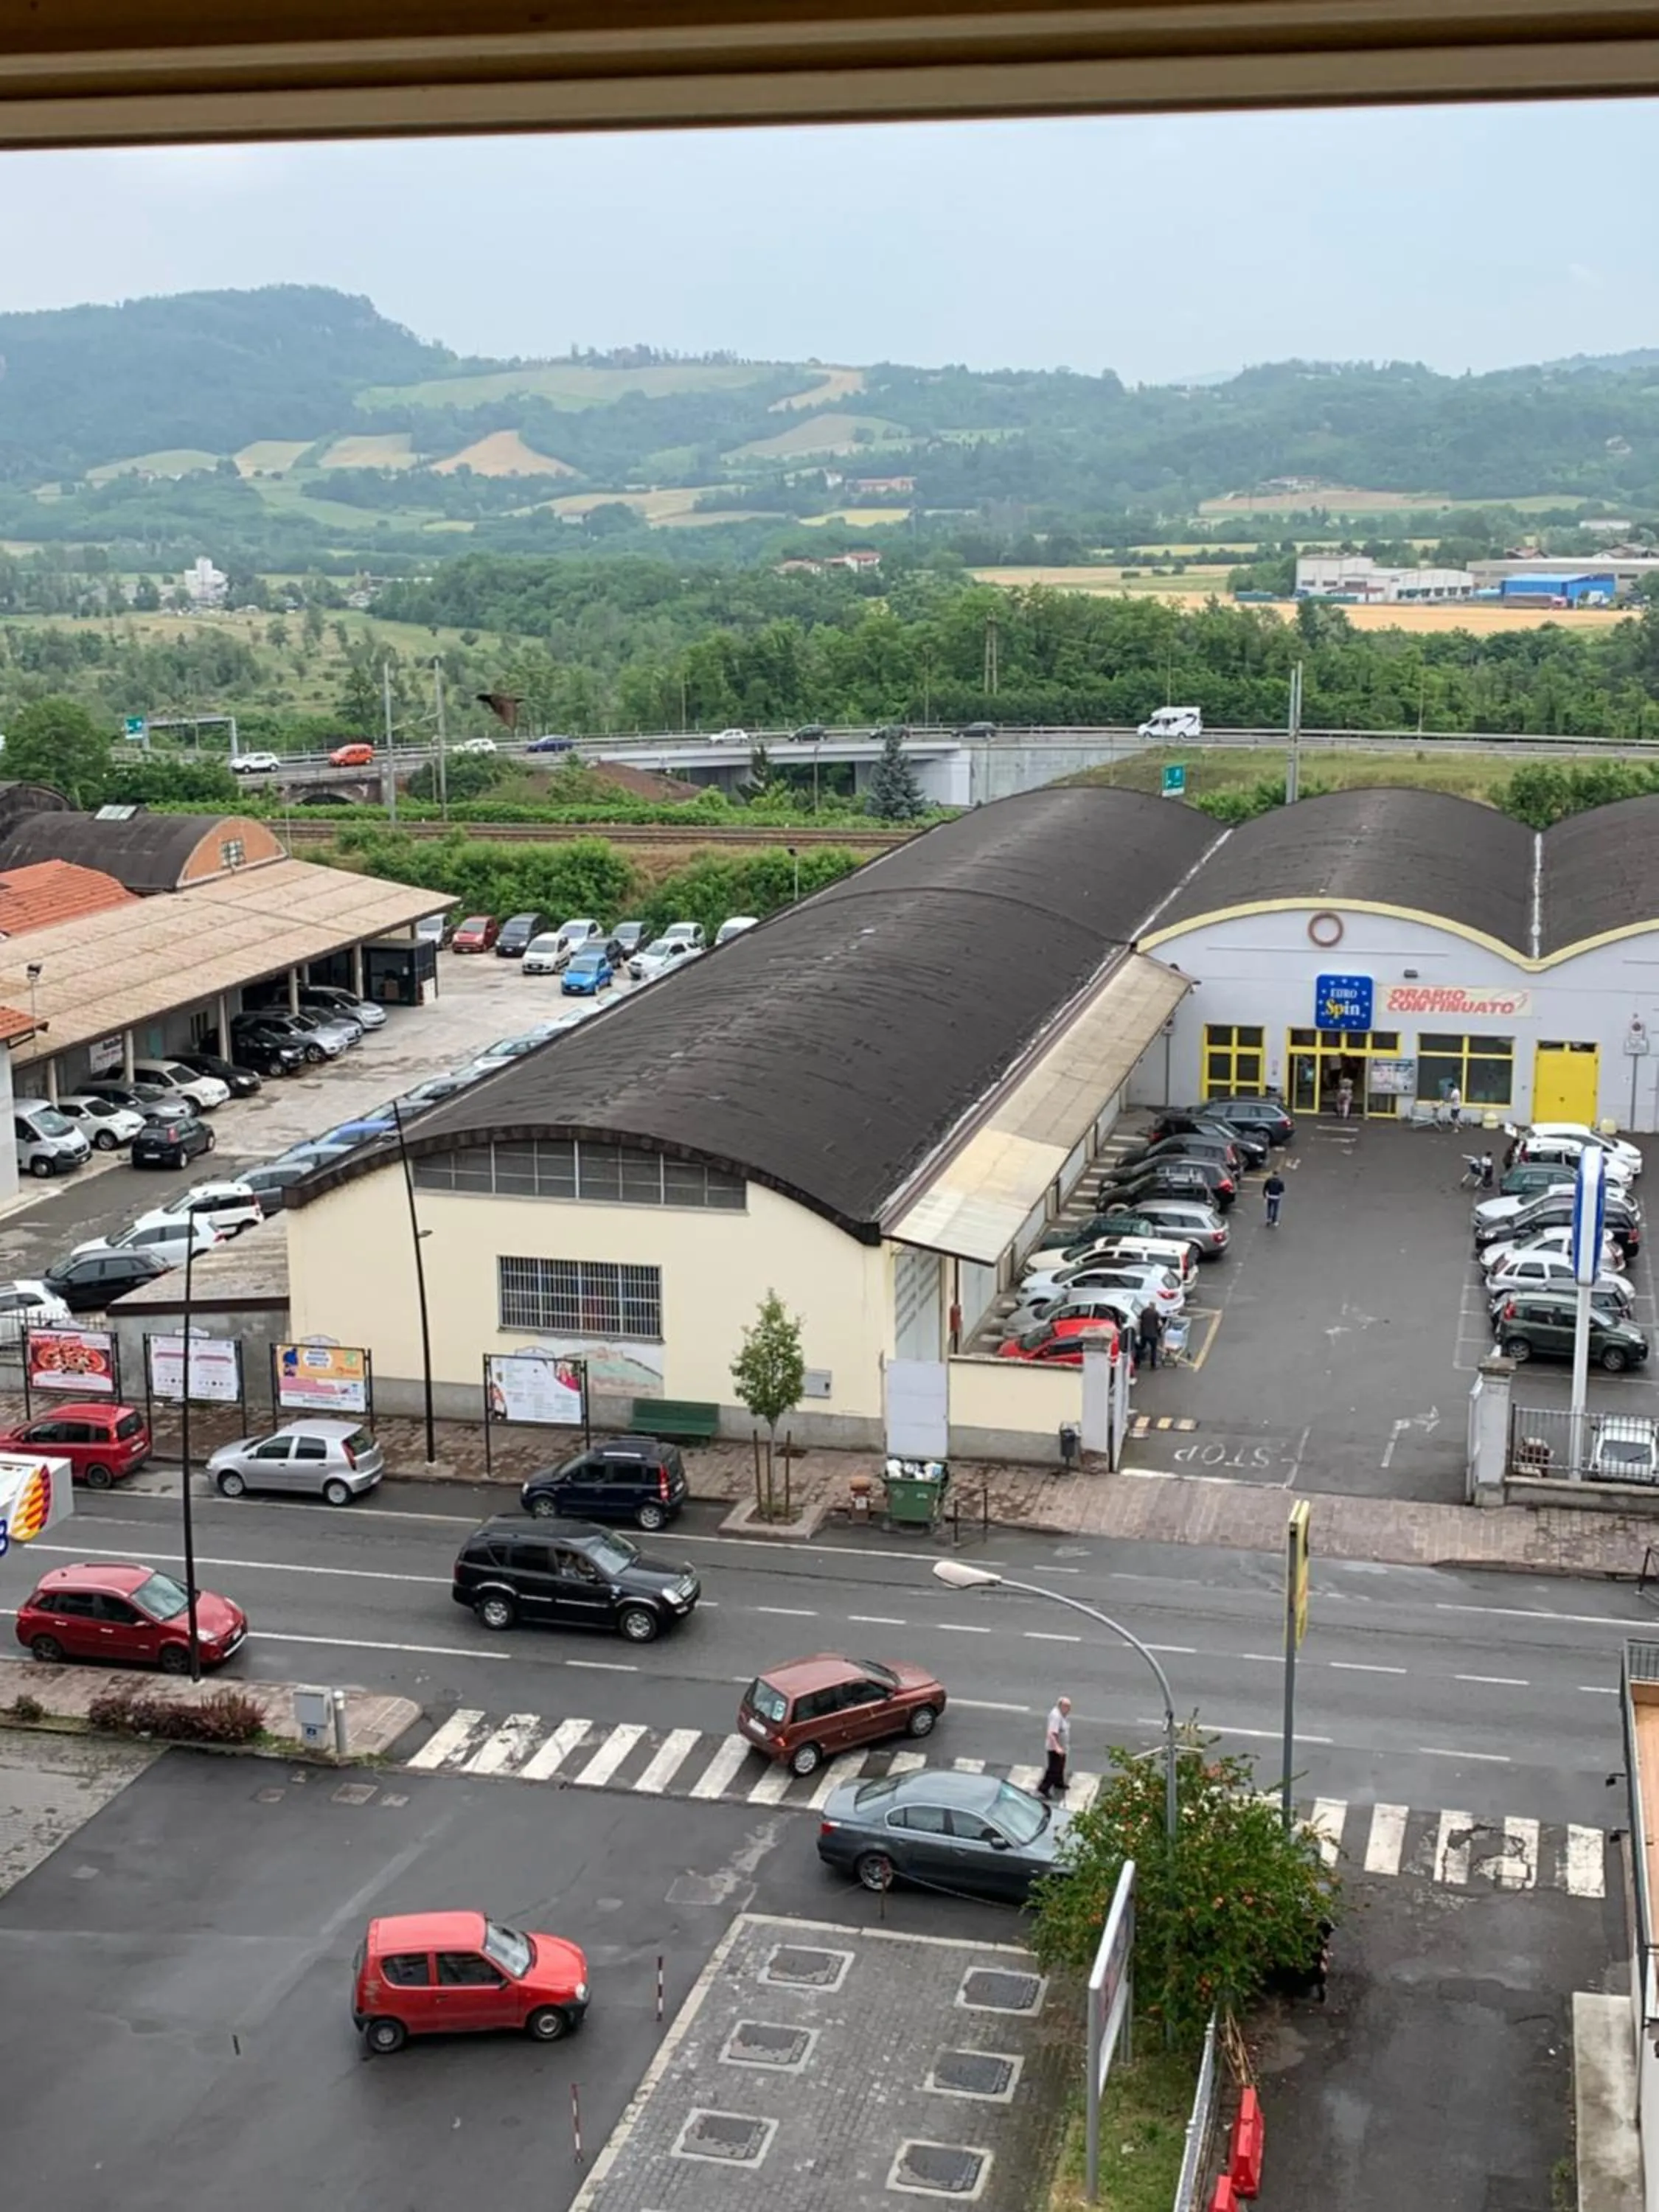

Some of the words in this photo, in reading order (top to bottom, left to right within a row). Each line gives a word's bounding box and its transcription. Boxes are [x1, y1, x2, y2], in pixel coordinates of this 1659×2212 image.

[1330, 987, 1358, 999] EURO
[1390, 988, 1467, 1002] ORARIO
[1326, 997, 1360, 1019] Spin
[1386, 998, 1516, 1015] CONTINUATO
[1173, 1443, 1270, 1469] STOP
